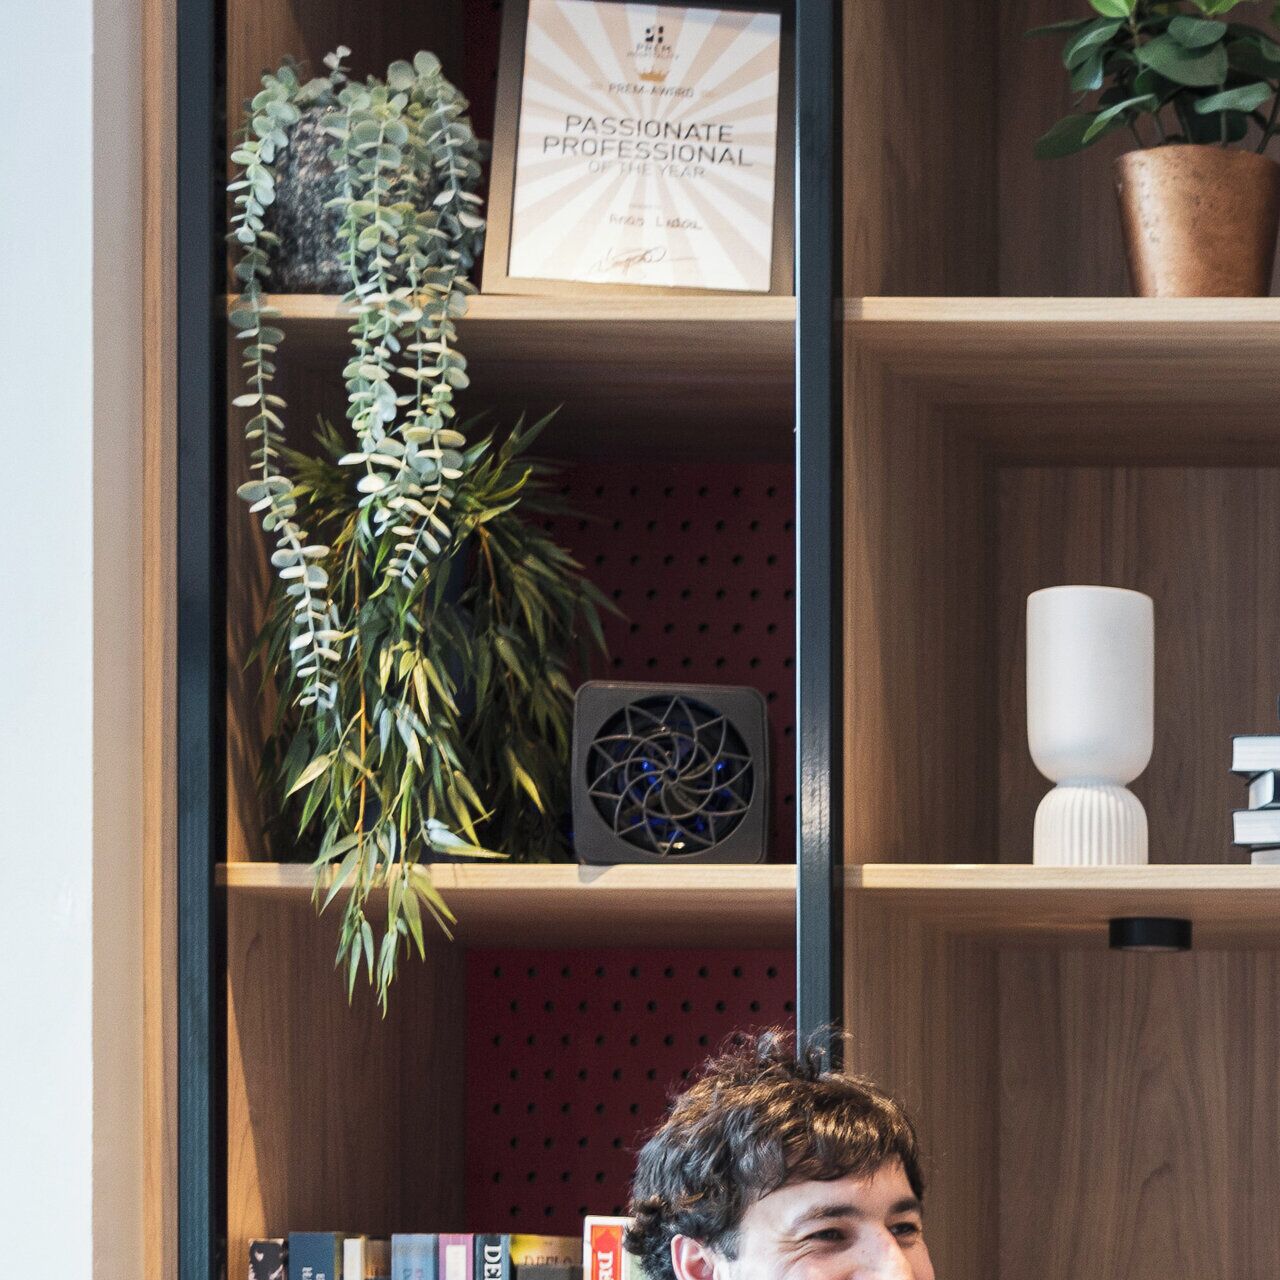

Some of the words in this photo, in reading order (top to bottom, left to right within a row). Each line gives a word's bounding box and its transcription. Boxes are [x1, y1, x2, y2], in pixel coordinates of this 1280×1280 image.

[565, 115, 734, 144] PASSIONATE
[543, 135, 754, 168] PROFESSIONAL
[657, 164, 706, 179] YEAR
